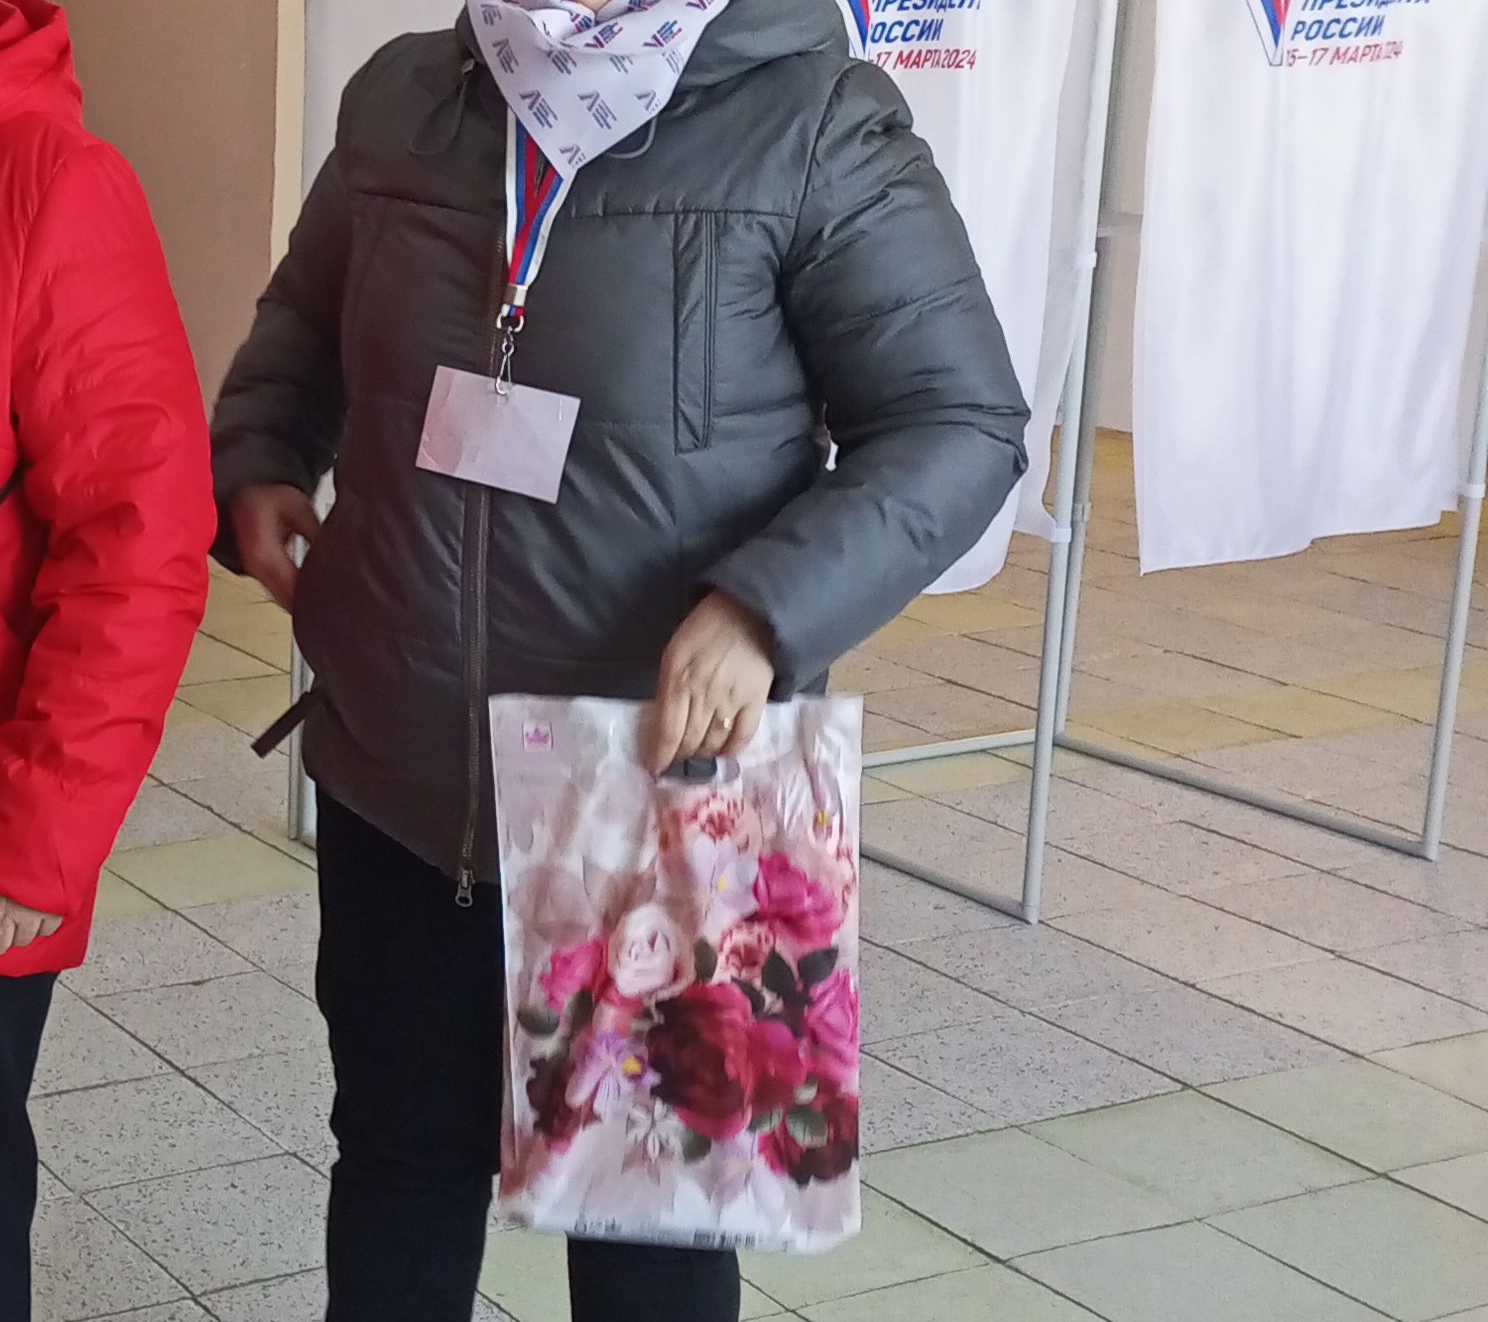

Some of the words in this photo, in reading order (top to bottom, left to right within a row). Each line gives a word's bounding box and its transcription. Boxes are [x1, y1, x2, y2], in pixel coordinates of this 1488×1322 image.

[870, 18, 944, 44] ОССИИ
[1290, 15, 1385, 42] РОССИИ
[940, 49, 977, 70] 2024
